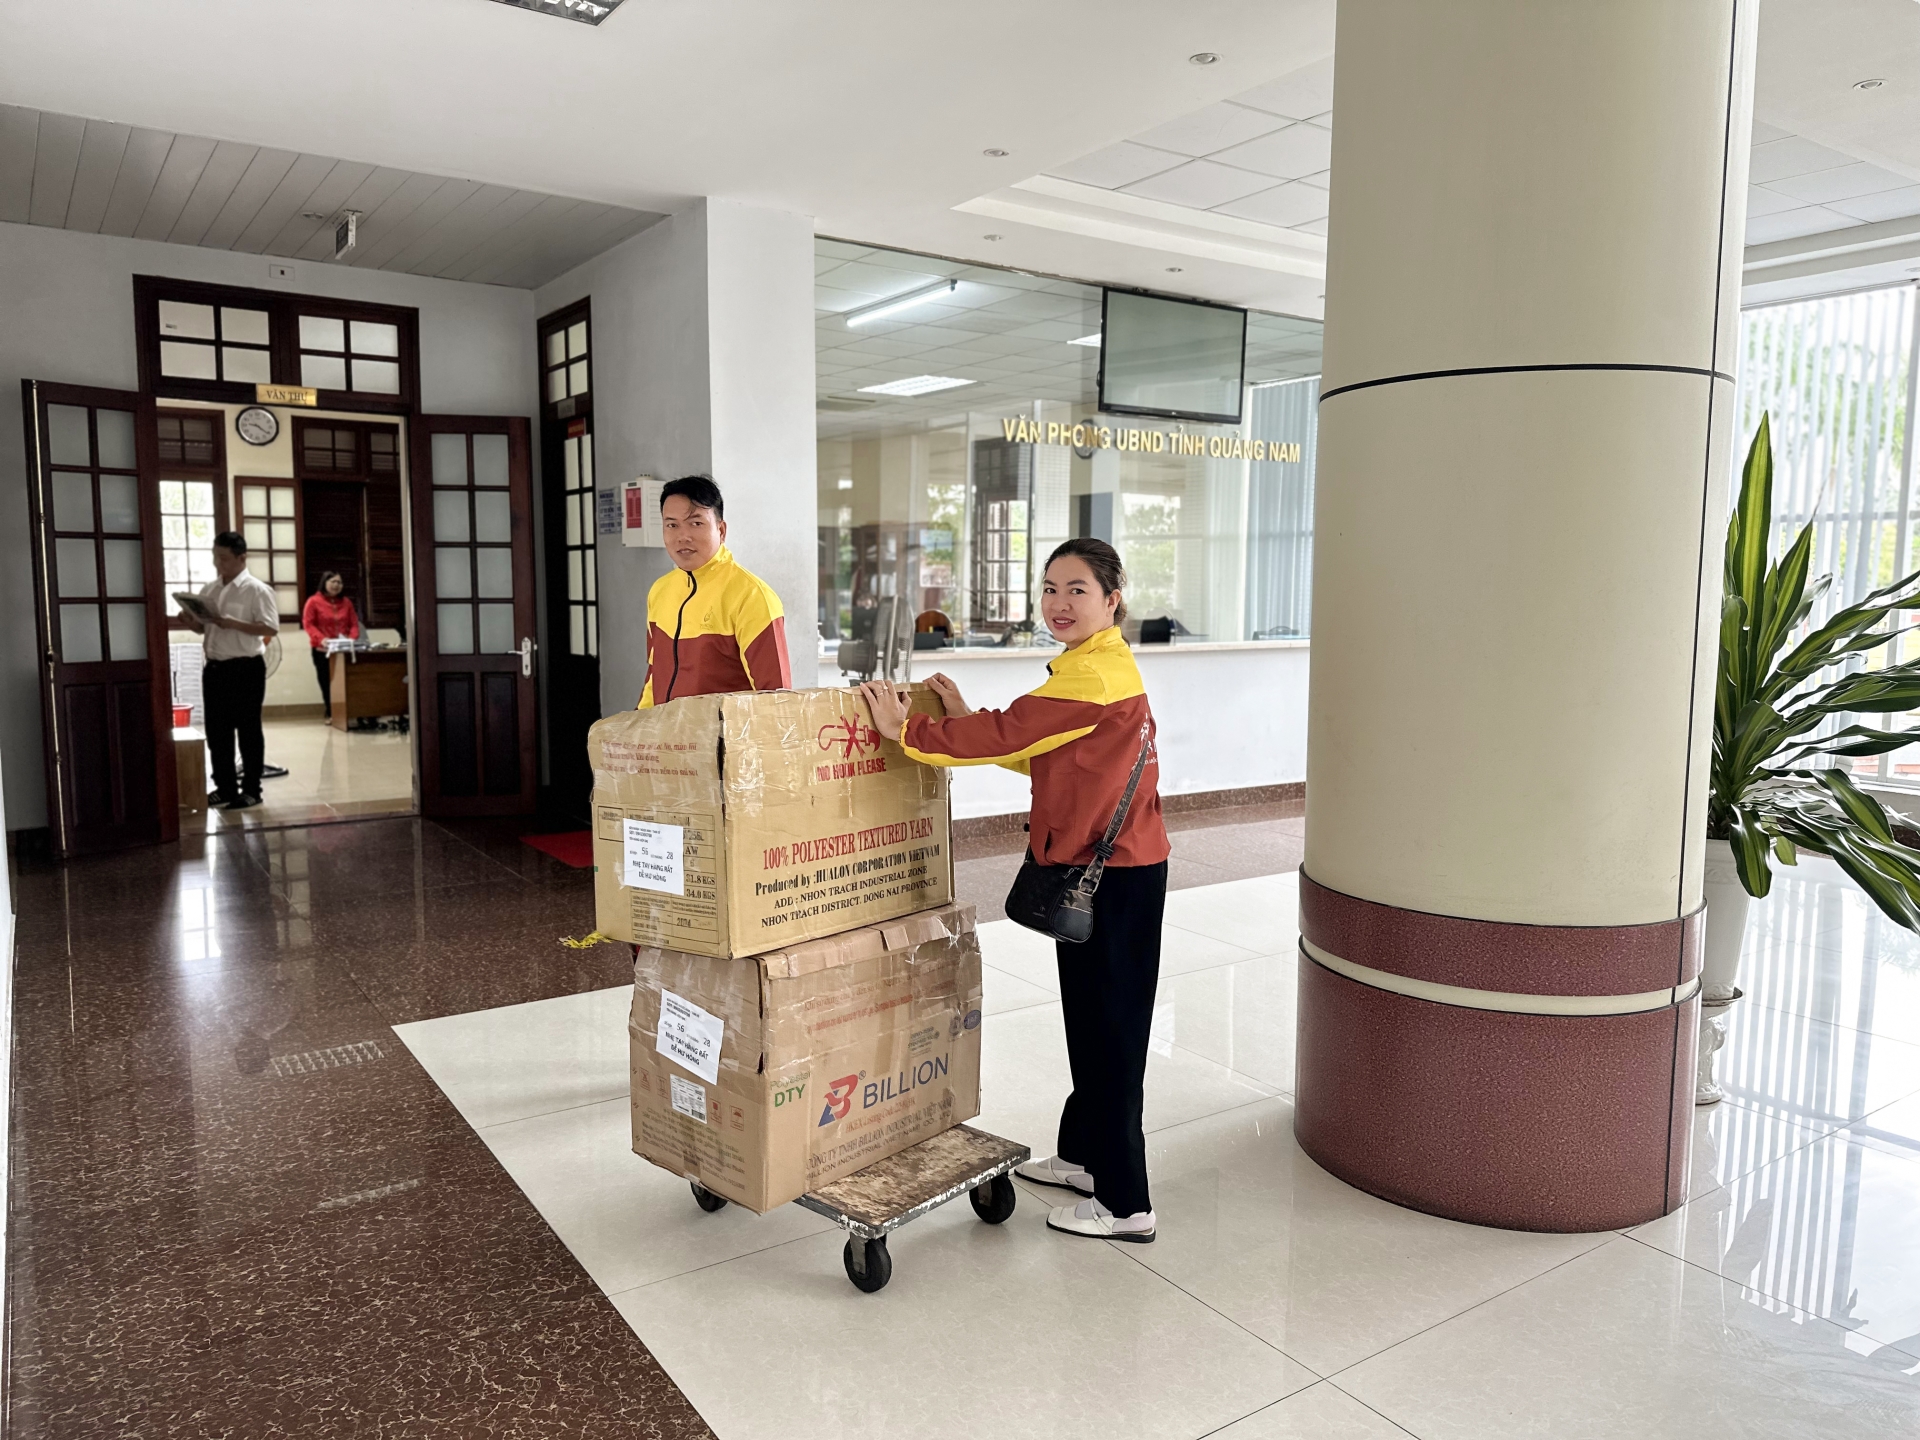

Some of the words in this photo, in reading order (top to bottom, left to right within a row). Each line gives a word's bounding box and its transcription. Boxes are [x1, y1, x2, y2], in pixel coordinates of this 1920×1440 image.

[266, 388, 286, 400] VĂN
[1004, 413, 1041, 444] VĂN
[1116, 428, 1164, 453] UBND
[1168, 424, 1205, 456] TỈNH
[1209, 430, 1265, 461] QUẢNG
[1269, 442, 1301, 463] NAM
[817, 765, 831, 782] NO
[832, 761, 855, 780] HOOK
[857, 757, 887, 776] PLEASE
[666, 851, 674, 860] 28
[685, 846, 699, 855] AW
[763, 846, 789, 870] 100%
[791, 833, 855, 865] POLYESTER
[858, 822, 908, 851] TEXTURED
[909, 817, 934, 840] YARN
[642, 861, 650, 869] TAY
[755, 873, 799, 896] Produced
[801, 873, 810, 888] by
[852, 851, 907, 875] CORPORATION
[908, 844, 940, 862] VIETNAM
[702, 876, 716, 886] KGS
[774, 897, 794, 909] ADD
[800, 889, 826, 903] NHON
[829, 882, 858, 897] TRACH
[859, 871, 907, 889] INDUSTRIAL
[907, 865, 928, 878] ZONE
[702, 890, 716, 901] KGS
[761, 913, 789, 928] NHON
[789, 905, 819, 921] TRACH
[863, 890, 885, 903] DONG
[886, 888, 900, 897] NAI
[901, 877, 938, 894] PROVINCE
[676, 1022, 685, 1033] 56
[703, 1037, 710, 1048] 28
[770, 1070, 811, 1092] Poyester
[862, 1053, 949, 1110] BILLION
[774, 1083, 807, 1108] DTY
[858, 1128, 884, 1148] BILLION
[885, 1110, 921, 1134] INDUSTRIAL
[837, 1141, 882, 1168] INDUSTRIAL
